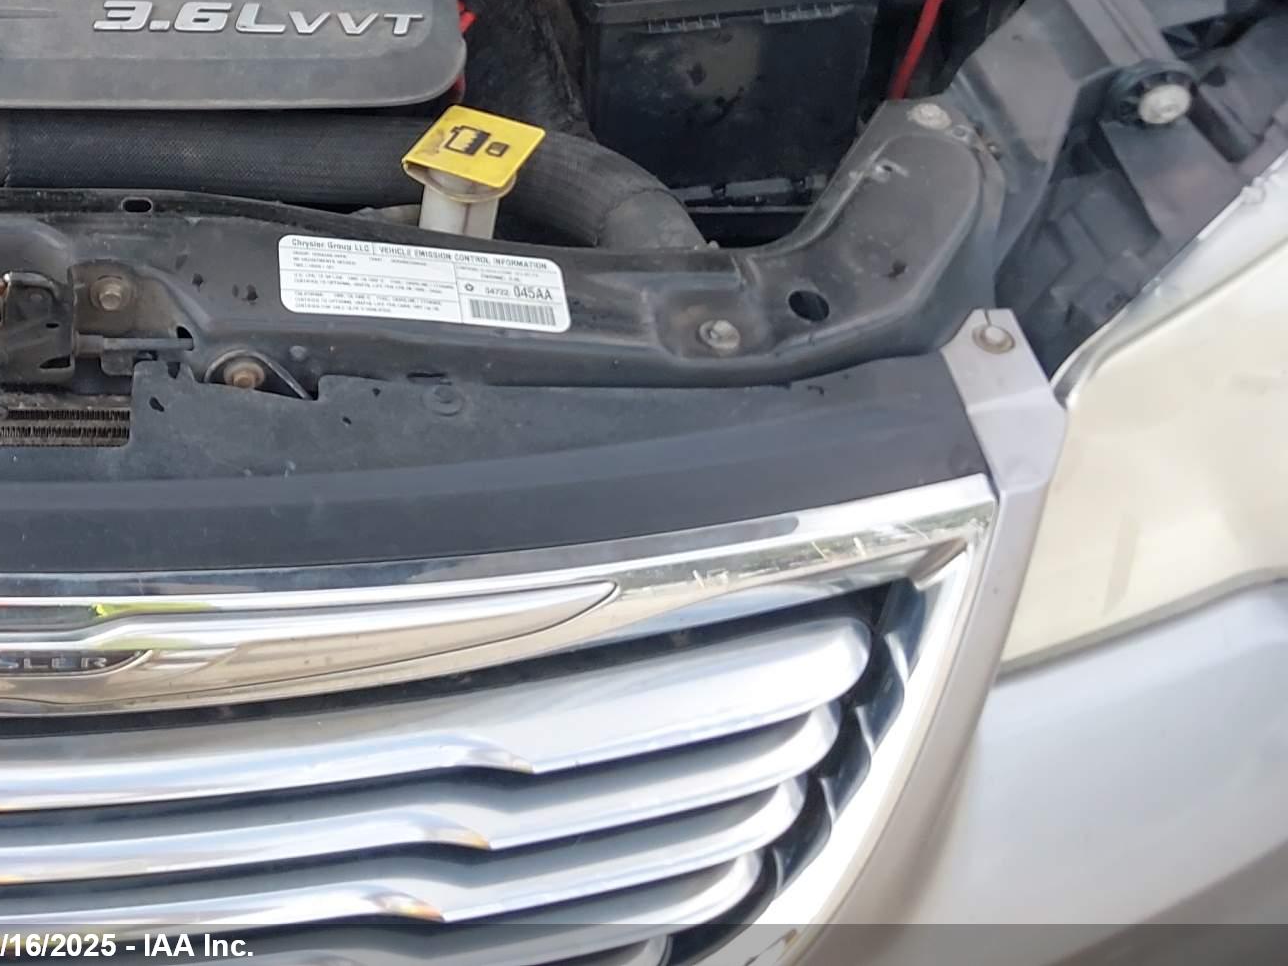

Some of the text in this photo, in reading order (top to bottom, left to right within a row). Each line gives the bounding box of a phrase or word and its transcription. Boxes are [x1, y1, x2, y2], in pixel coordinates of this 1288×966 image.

[291, 238, 370, 252] Chrysler Group LLC
[378, 245, 548, 270] VEHICLE EMISSION CONTROL INFORMATION
[513, 284, 553, 301] 045AA
